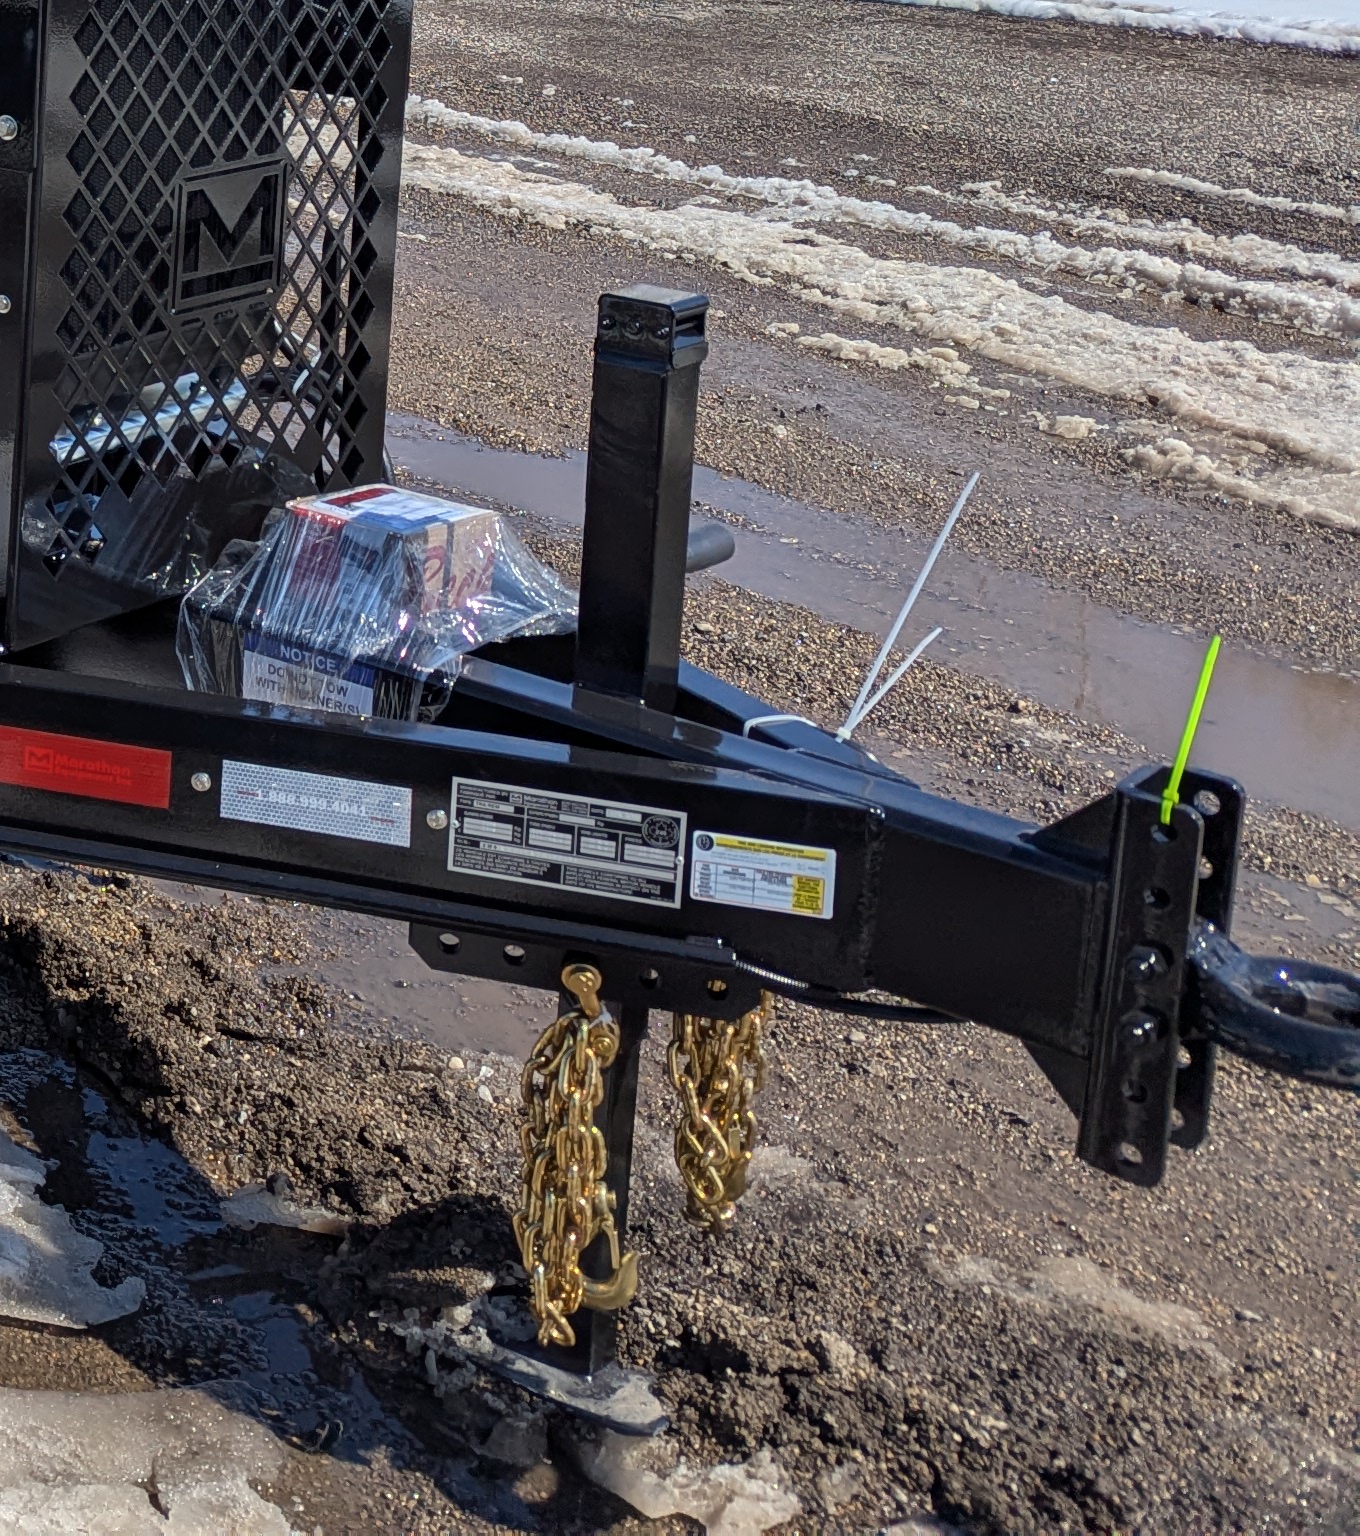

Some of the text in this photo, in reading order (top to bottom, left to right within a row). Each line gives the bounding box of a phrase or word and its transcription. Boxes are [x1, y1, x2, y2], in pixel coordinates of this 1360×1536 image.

[280, 645, 337, 672] NOTICE
[268, 664, 284, 678] DO
[54, 754, 131, 776] Marathon
[524, 795, 558, 807] Marathon
